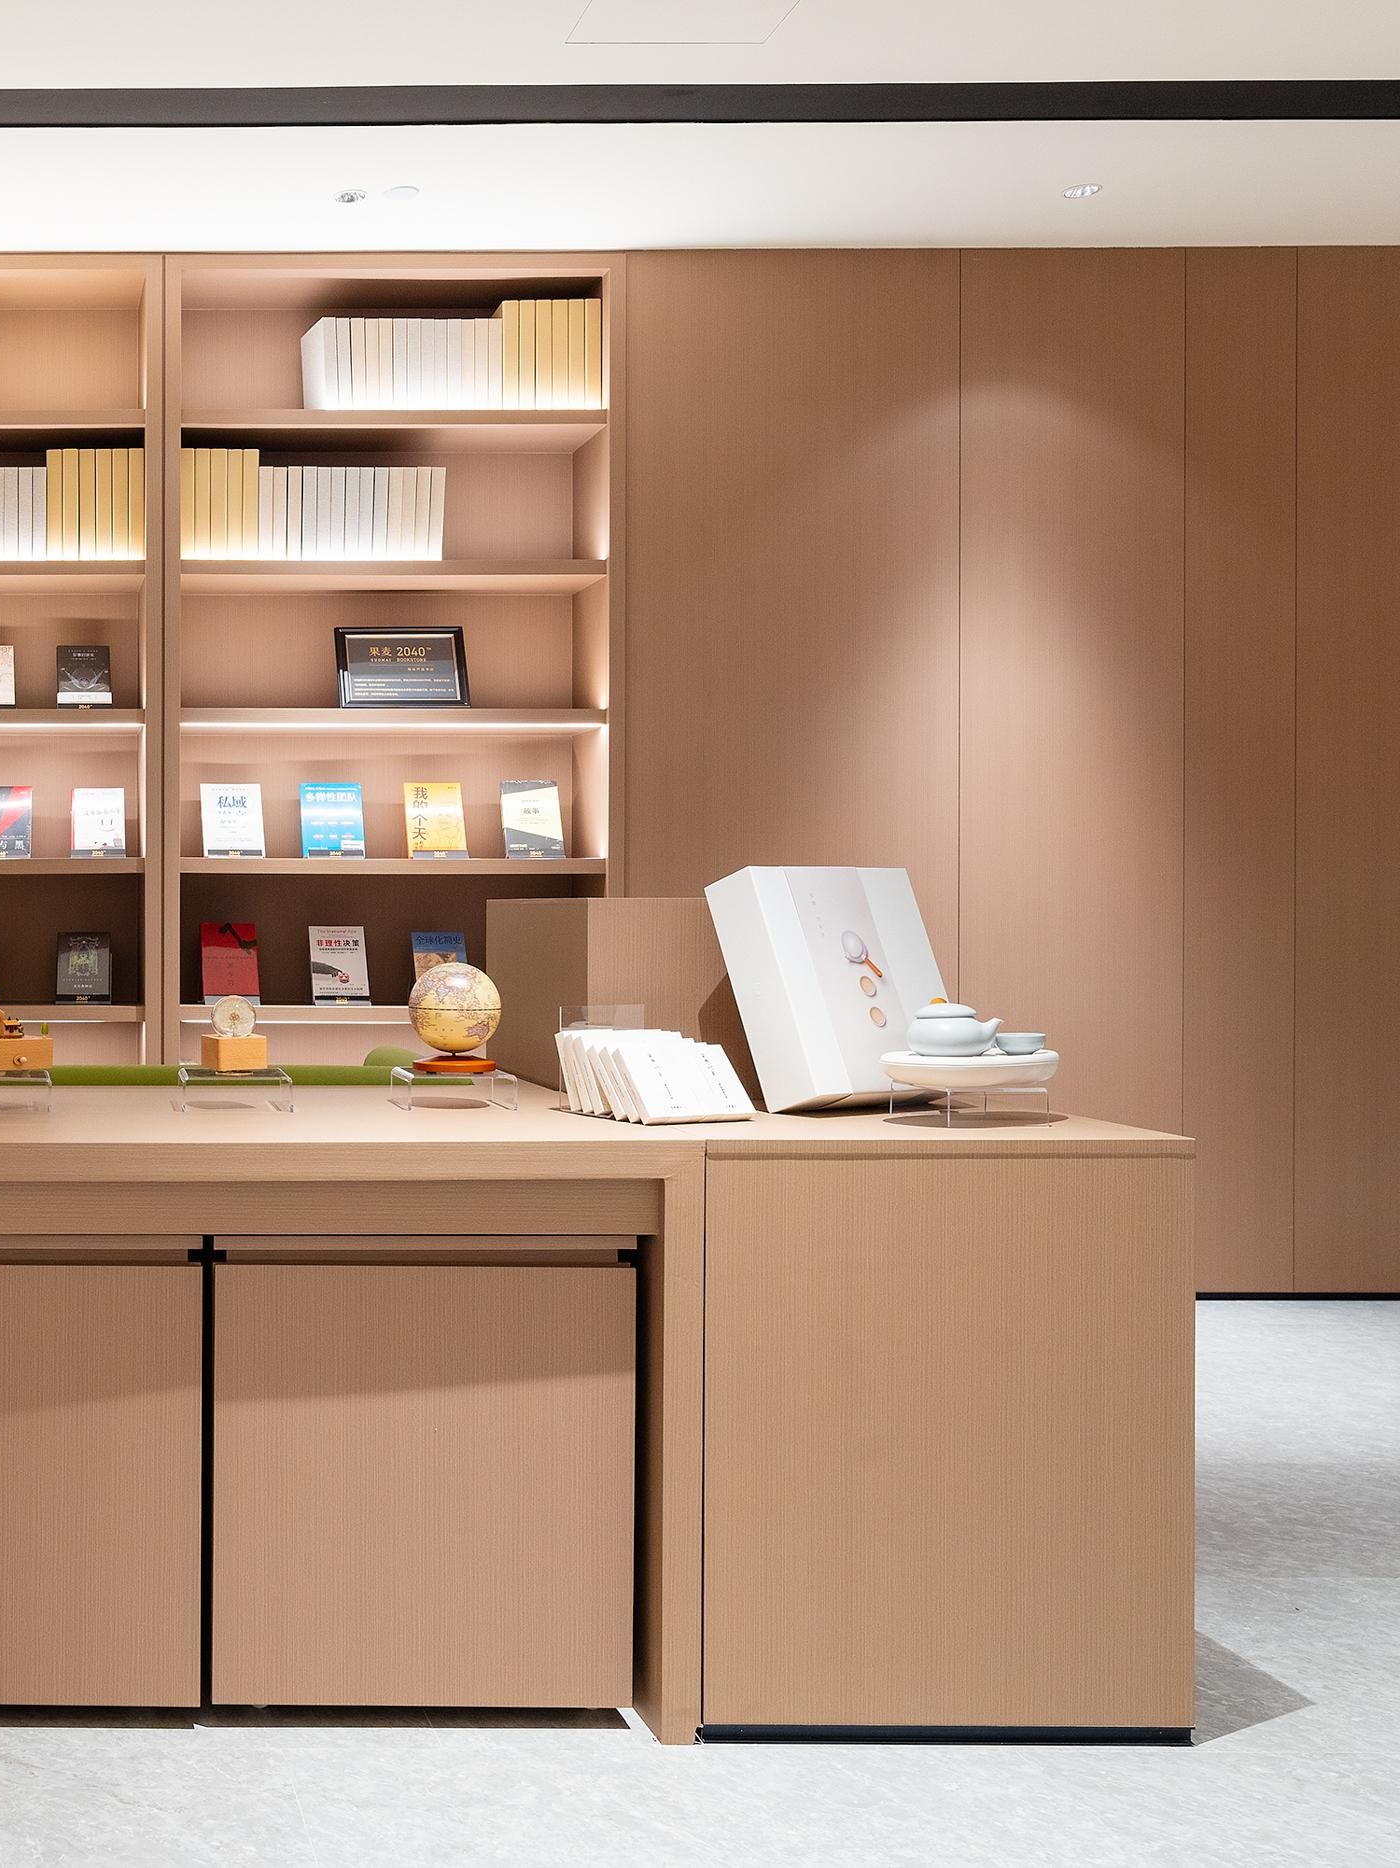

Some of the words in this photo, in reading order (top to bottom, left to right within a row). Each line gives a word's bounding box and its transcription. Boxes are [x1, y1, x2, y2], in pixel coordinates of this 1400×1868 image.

[369, 646, 392, 656] 果麦
[217, 795, 247, 808] 私域
[411, 784, 429, 841] 我的个天
[317, 939, 359, 947] 非理性决策
[416, 935, 462, 945] 全球化简史
